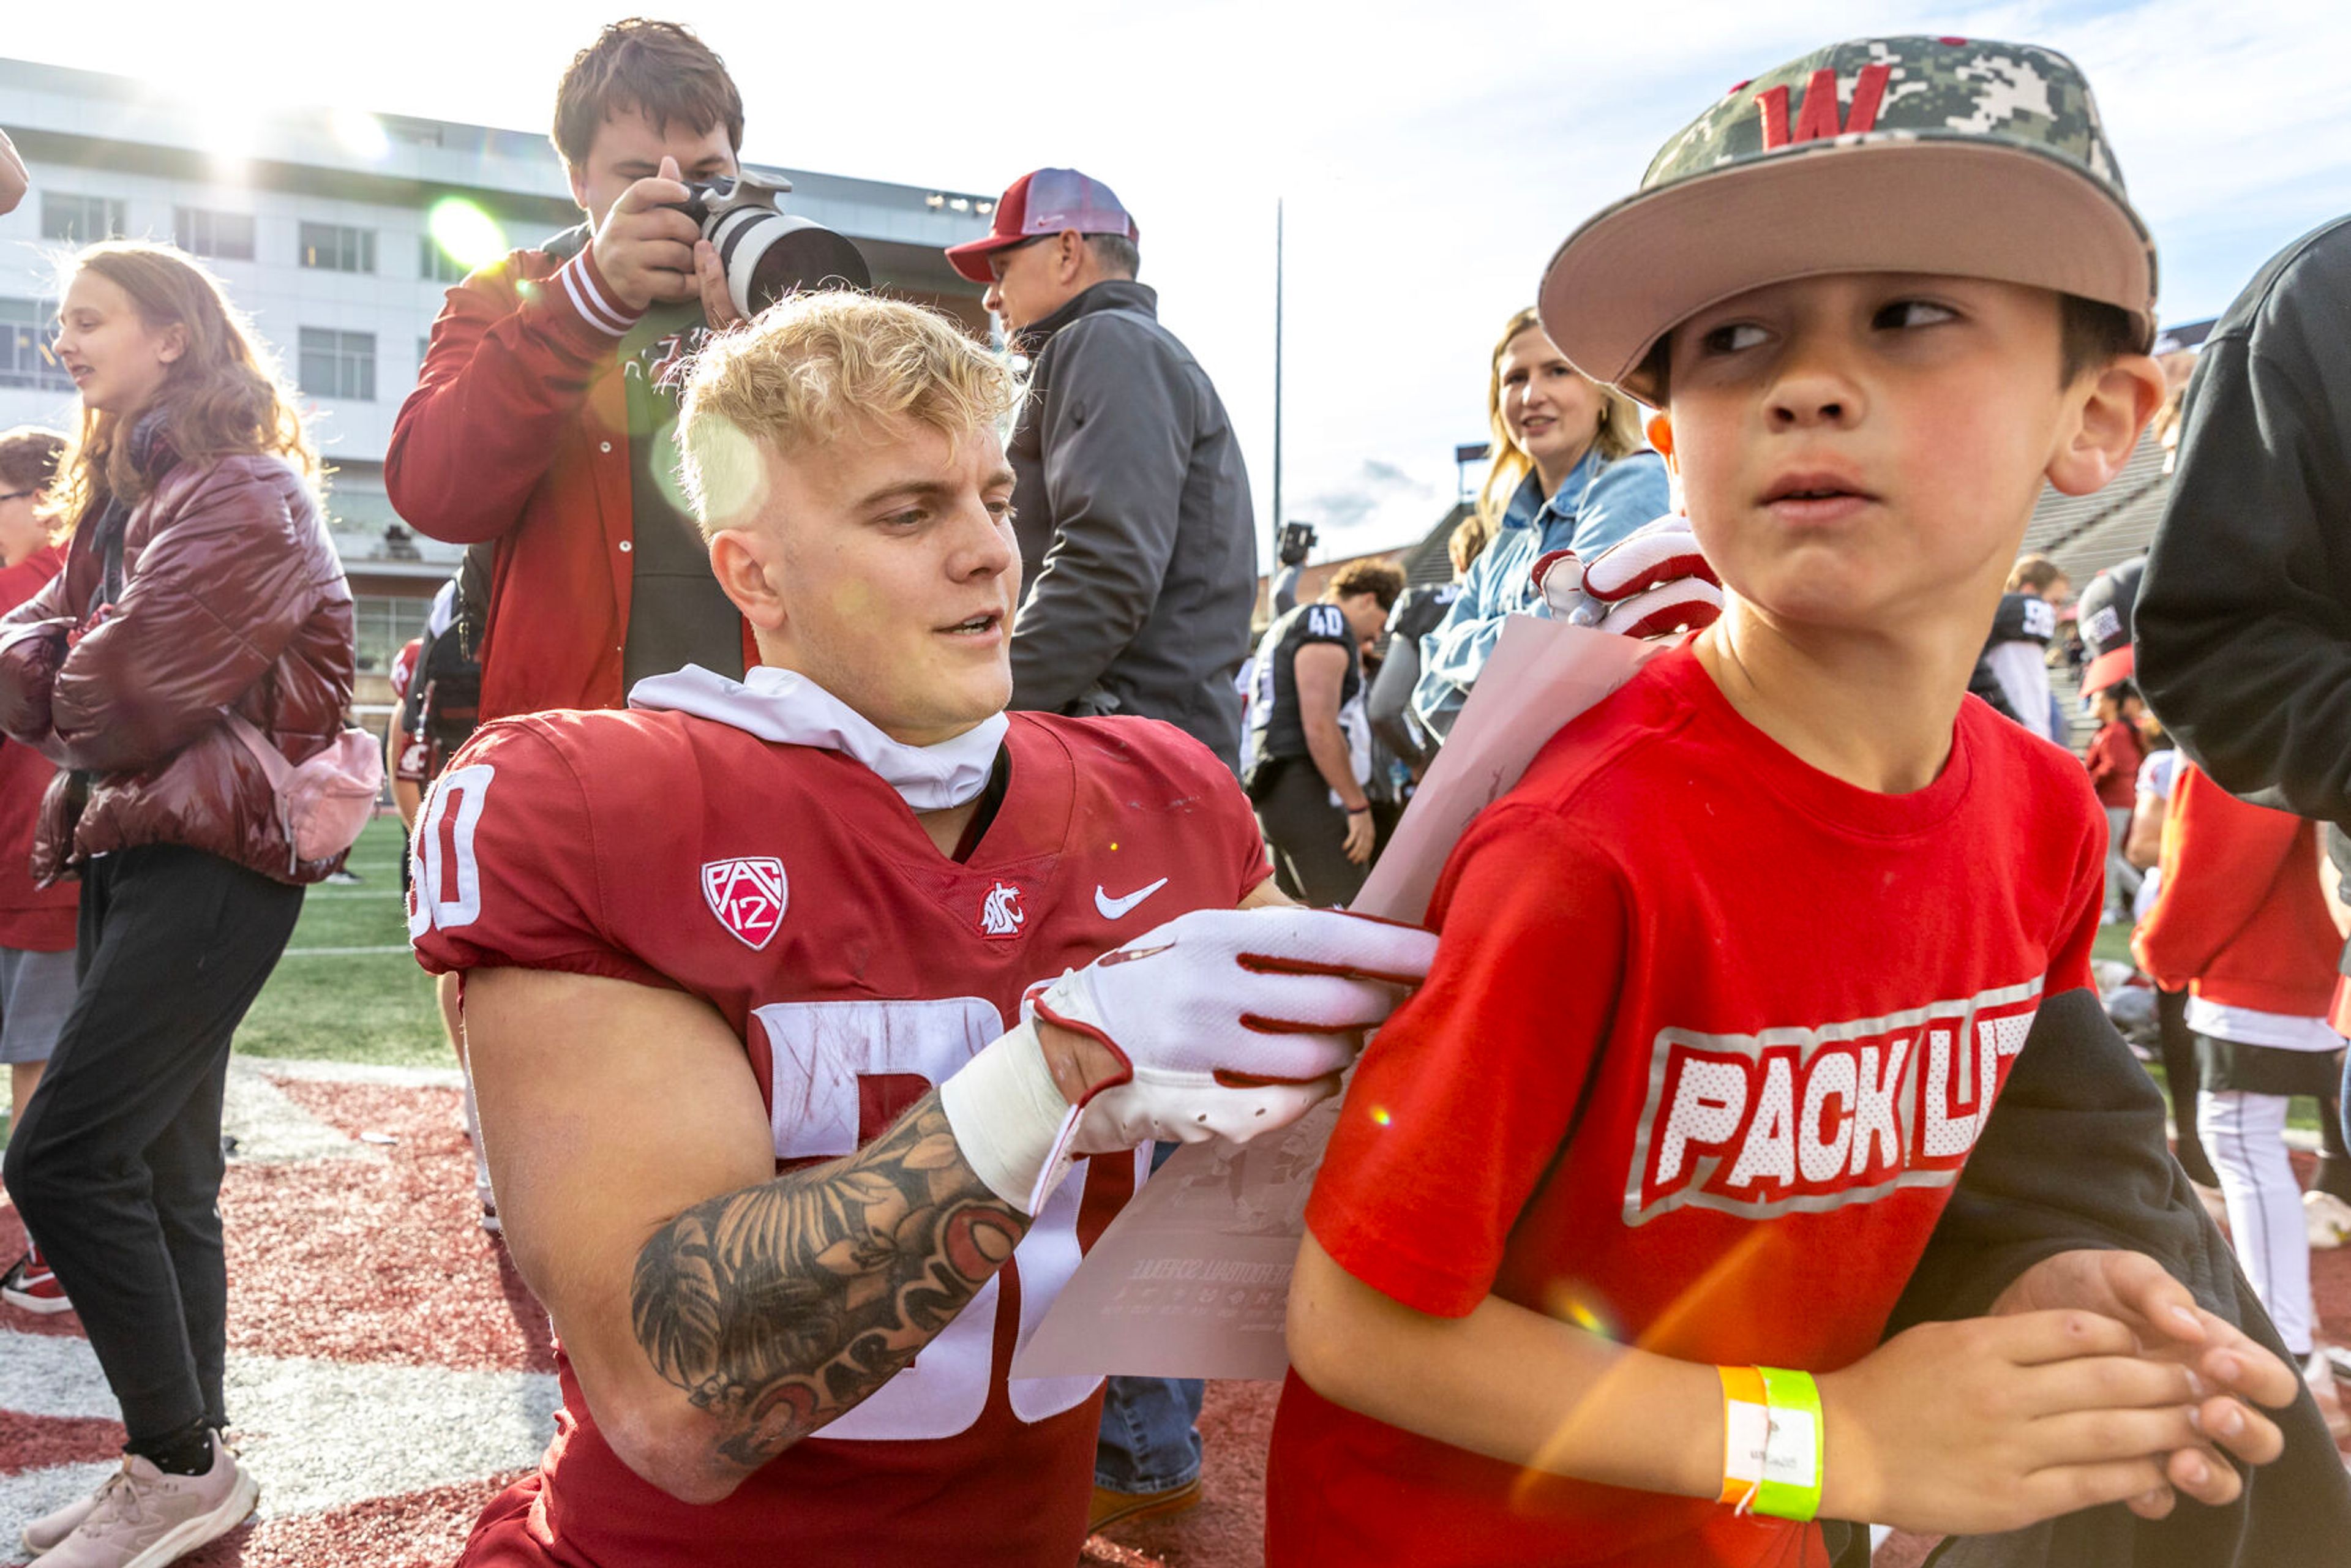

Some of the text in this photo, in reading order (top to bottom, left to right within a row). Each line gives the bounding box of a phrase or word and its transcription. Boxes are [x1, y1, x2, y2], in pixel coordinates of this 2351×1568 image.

[1752, 65, 1891, 154] W
[1308, 606, 1343, 637] 40
[707, 861, 782, 914] PAC
[730, 896, 773, 930] 12
[1655, 1039, 1910, 1188] PACK
